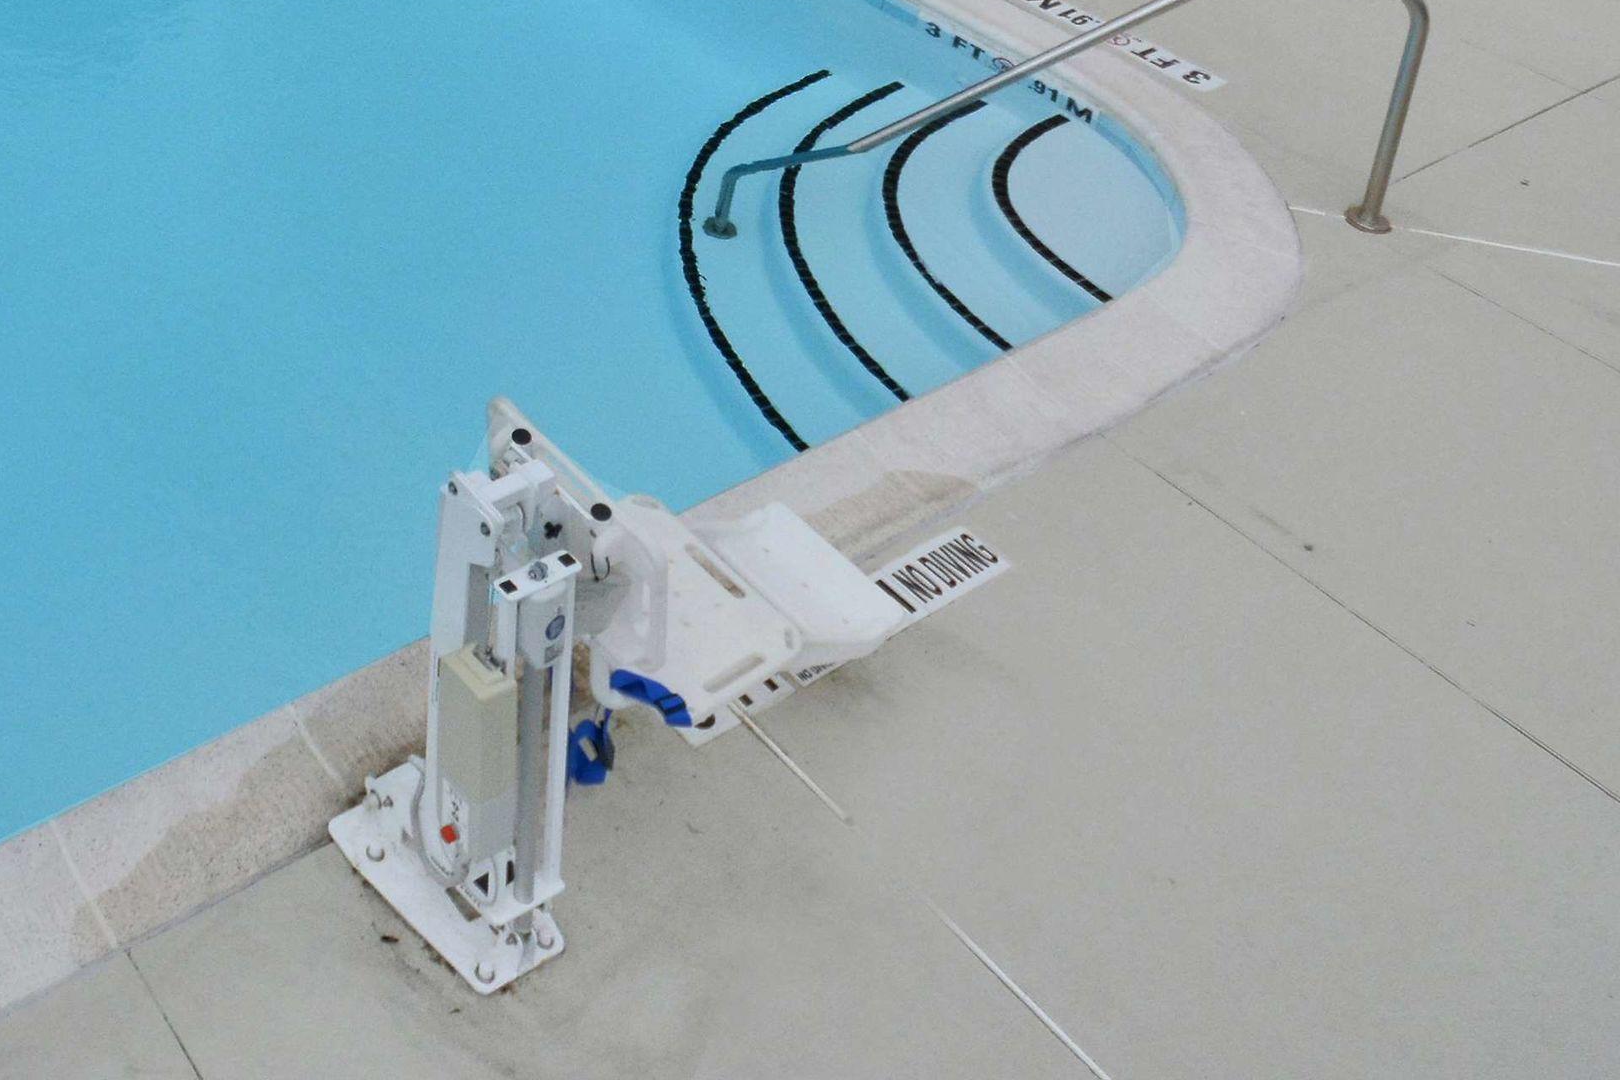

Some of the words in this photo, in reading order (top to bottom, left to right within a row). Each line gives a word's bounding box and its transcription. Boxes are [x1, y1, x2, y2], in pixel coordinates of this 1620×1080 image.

[924, 22, 942, 38] 3
[951, 35, 986, 60] FT
[1066, 96, 1095, 124] M
[1130, 48, 1180, 70] FT
[1182, 70, 1212, 85] 3
[917, 533, 999, 588] DIVING
[892, 564, 943, 604] NO
